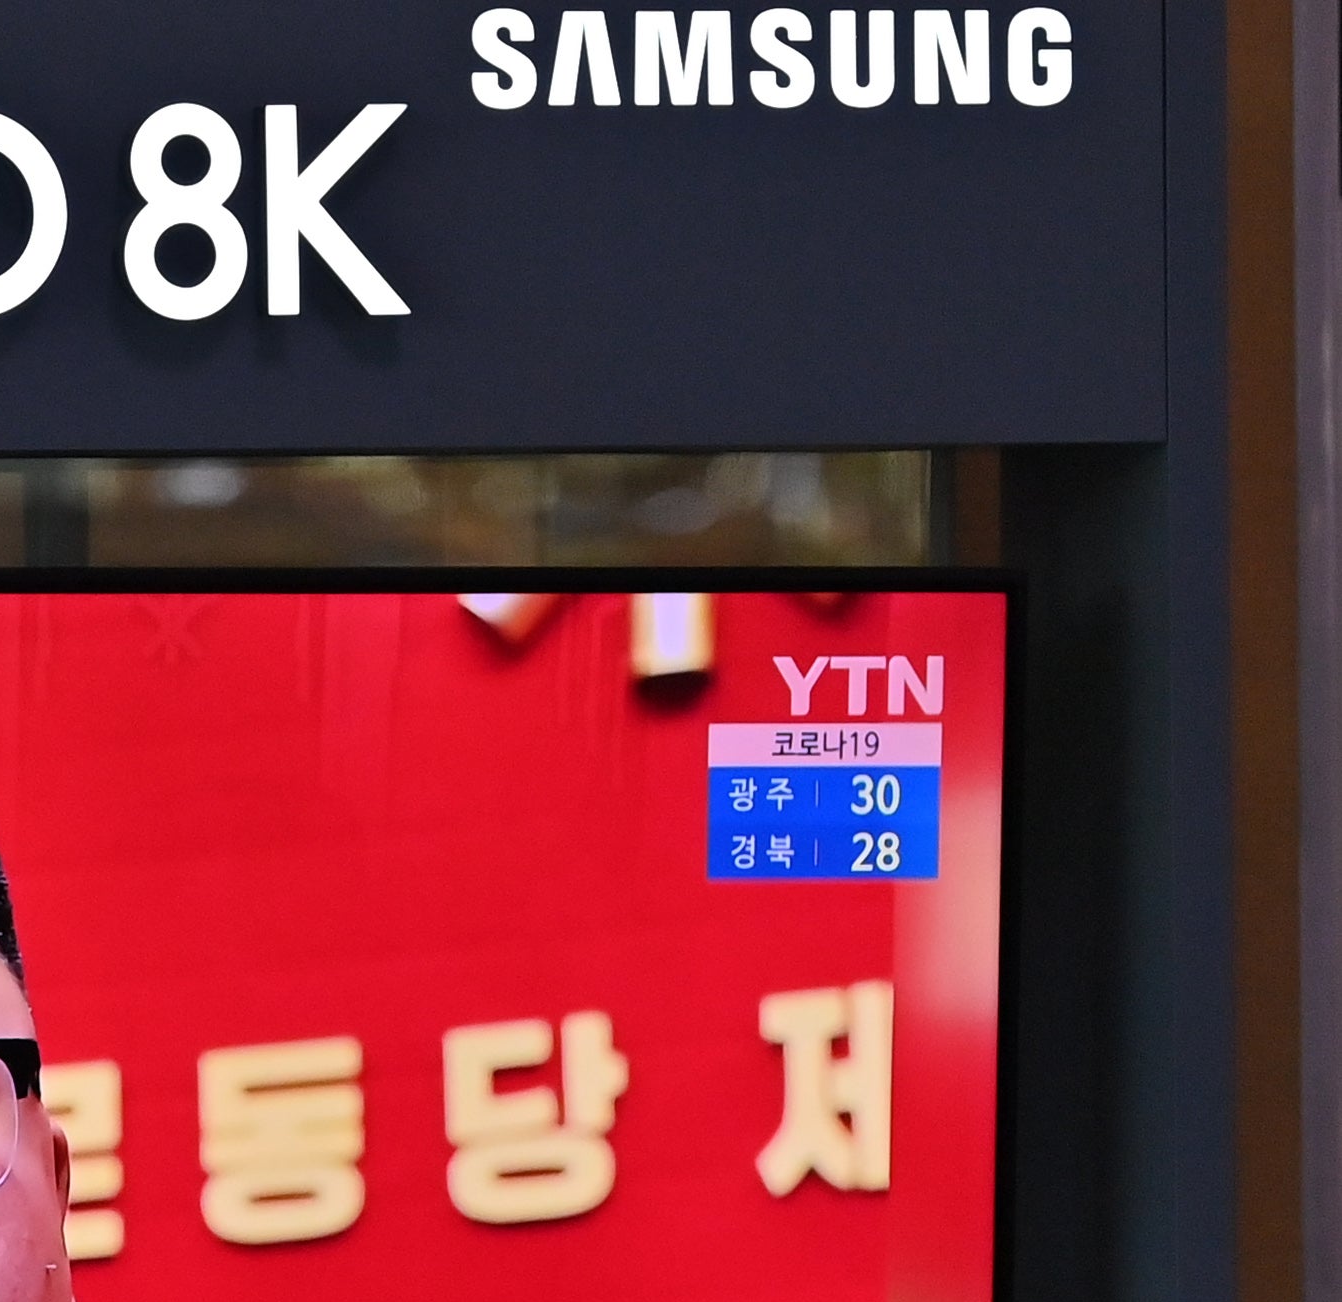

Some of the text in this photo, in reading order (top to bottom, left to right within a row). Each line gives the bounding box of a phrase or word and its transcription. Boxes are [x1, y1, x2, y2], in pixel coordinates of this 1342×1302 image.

[471, 7, 1073, 110] SAMSUNG
[123, 102, 412, 321] 8K
[772, 655, 944, 716] YTN
[771, 729, 880, 760] 코로나19
[728, 774, 901, 815] 광주 30
[730, 831, 901, 872] 경북 28
